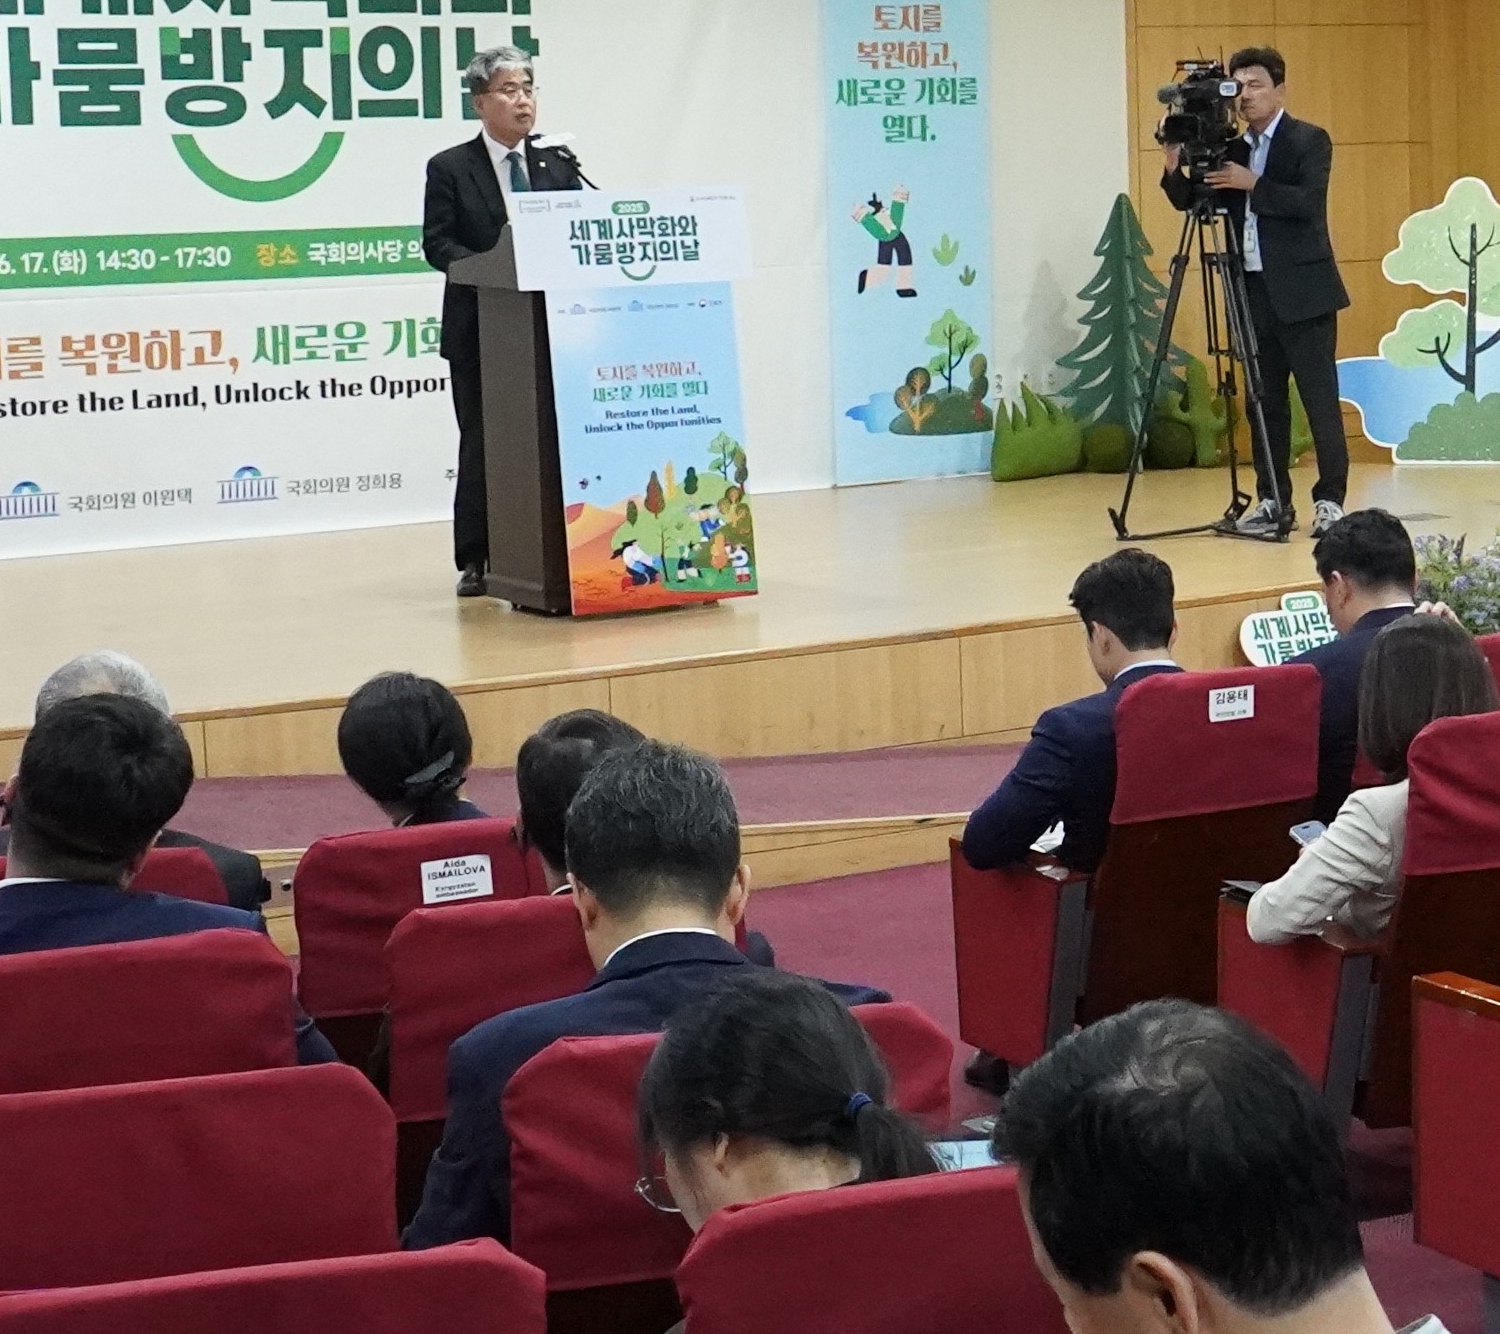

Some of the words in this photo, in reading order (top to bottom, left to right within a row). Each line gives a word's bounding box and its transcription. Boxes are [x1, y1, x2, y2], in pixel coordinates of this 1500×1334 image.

[873, 3, 942, 33] 토지를
[857, 40, 958, 73] 복원하고,
[835, 78, 907, 107] 새로운
[914, 76, 979, 106] 기회를
[882, 114, 937, 143] 열다.
[97, 247, 157, 271] 14:30
[174, 245, 232, 268] 17:30
[256, 242, 298, 267] 장소
[307, 240, 403, 266] 국회의사당
[407, 238, 425, 262] 의
[59, 329, 239, 377] 복원하고,
[252, 320, 369, 365] 새로운
[77, 391, 124, 413] the
[132, 386, 207, 412] Land,
[214, 379, 311, 405] Unlock
[319, 377, 363, 399] the
[370, 374, 450, 400] Oppor
[584, 423, 623, 434] Unlock
[626, 422, 644, 431] the
[646, 416, 722, 431] Opportunities
[605, 410, 648, 420] Restore
[651, 407, 669, 417] the
[67, 491, 136, 513] 국회의원
[142, 487, 193, 508] 이원택
[286, 476, 350, 496] 국회의원
[355, 472, 402, 492] 정희용
[1215, 689, 1248, 705] 김용태
[427, 865, 486, 880] ISMAILOVA
[443, 859, 467, 869] Aida
